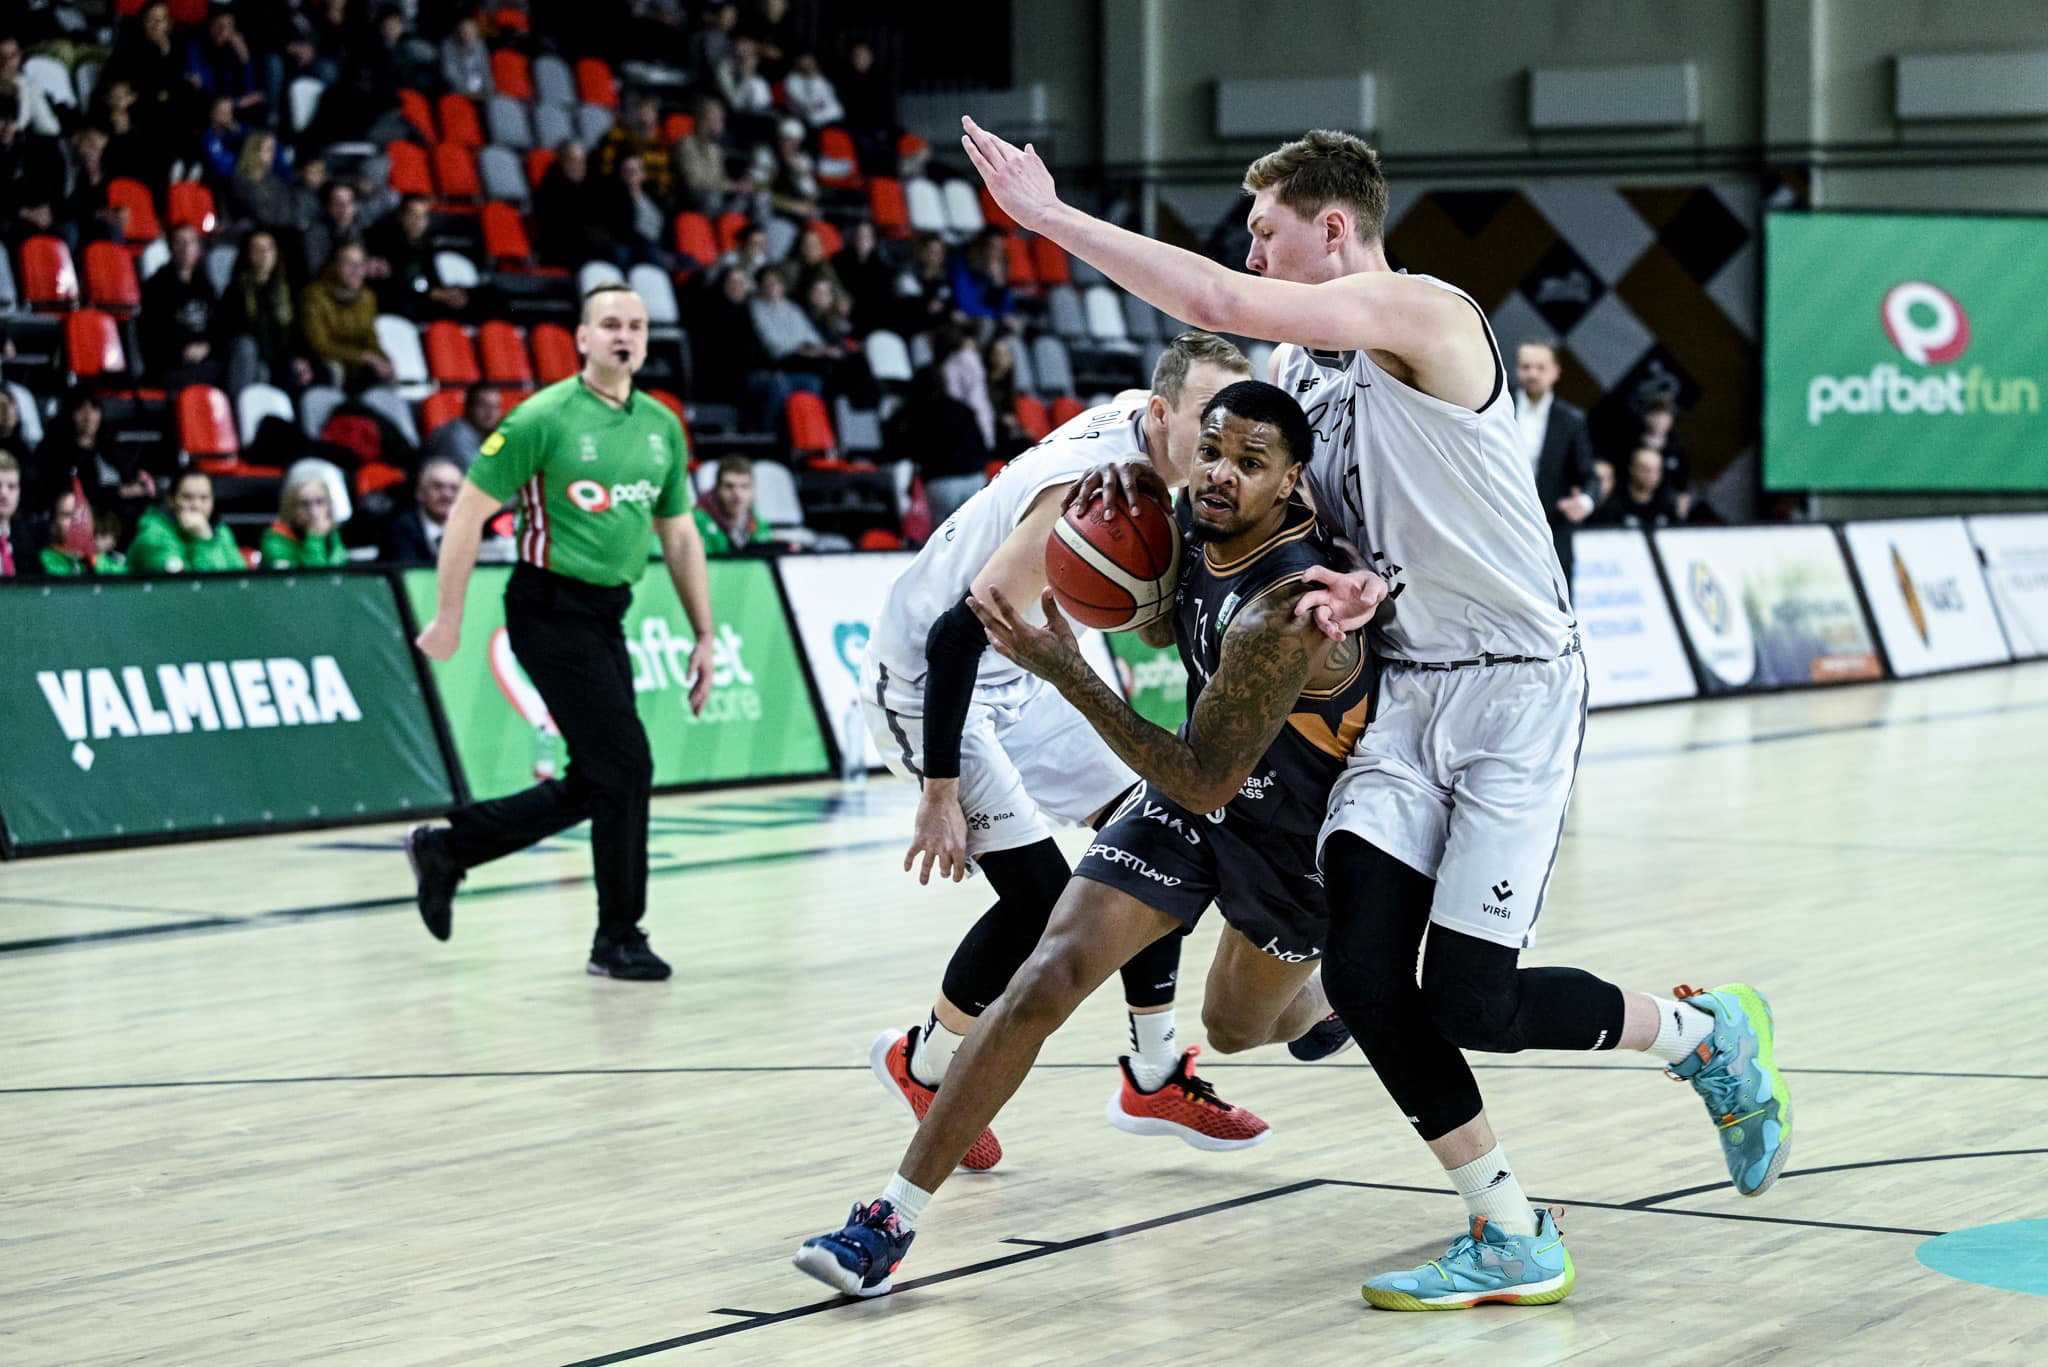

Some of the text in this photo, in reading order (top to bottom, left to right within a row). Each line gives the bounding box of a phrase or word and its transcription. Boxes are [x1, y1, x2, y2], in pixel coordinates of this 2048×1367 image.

[1807, 362, 2041, 426] pafbetfun
[625, 615, 755, 692] afbet
[36, 655, 363, 741] VALMIERA
[1142, 801, 1200, 846] VAKS
[1085, 843, 1182, 887] SPORTLAND
[1482, 903, 1511, 920] VIRŠI
